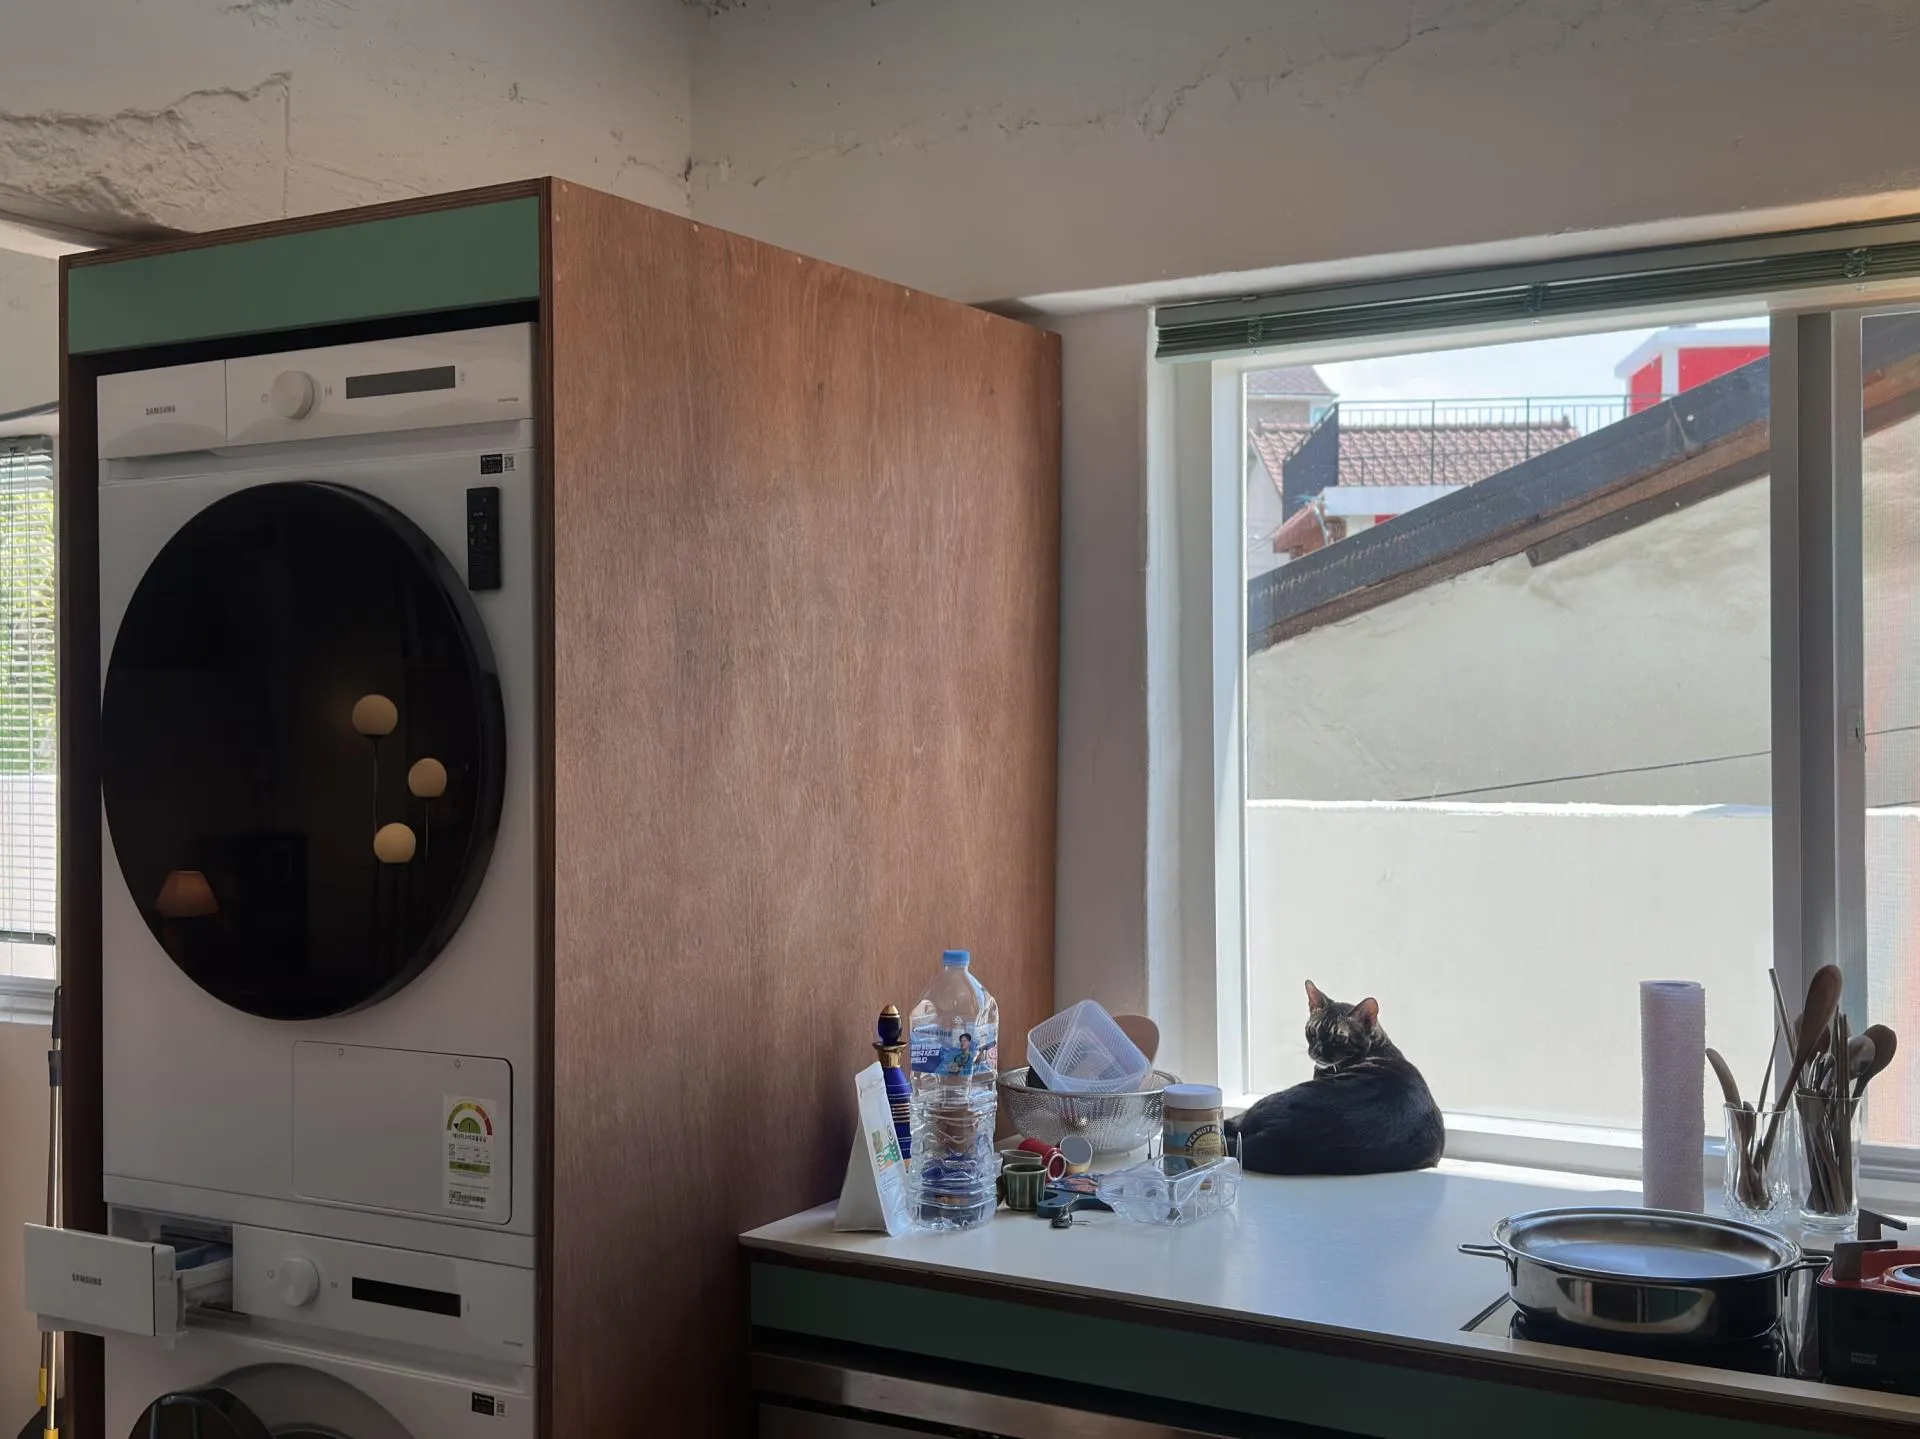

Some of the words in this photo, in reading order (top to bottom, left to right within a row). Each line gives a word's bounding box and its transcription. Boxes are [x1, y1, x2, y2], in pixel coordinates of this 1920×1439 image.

[146, 405, 176, 416] SAMSUNG
[1187, 1126, 1211, 1147] PEANUT
[72, 1273, 102, 1286] SAMSUNG
